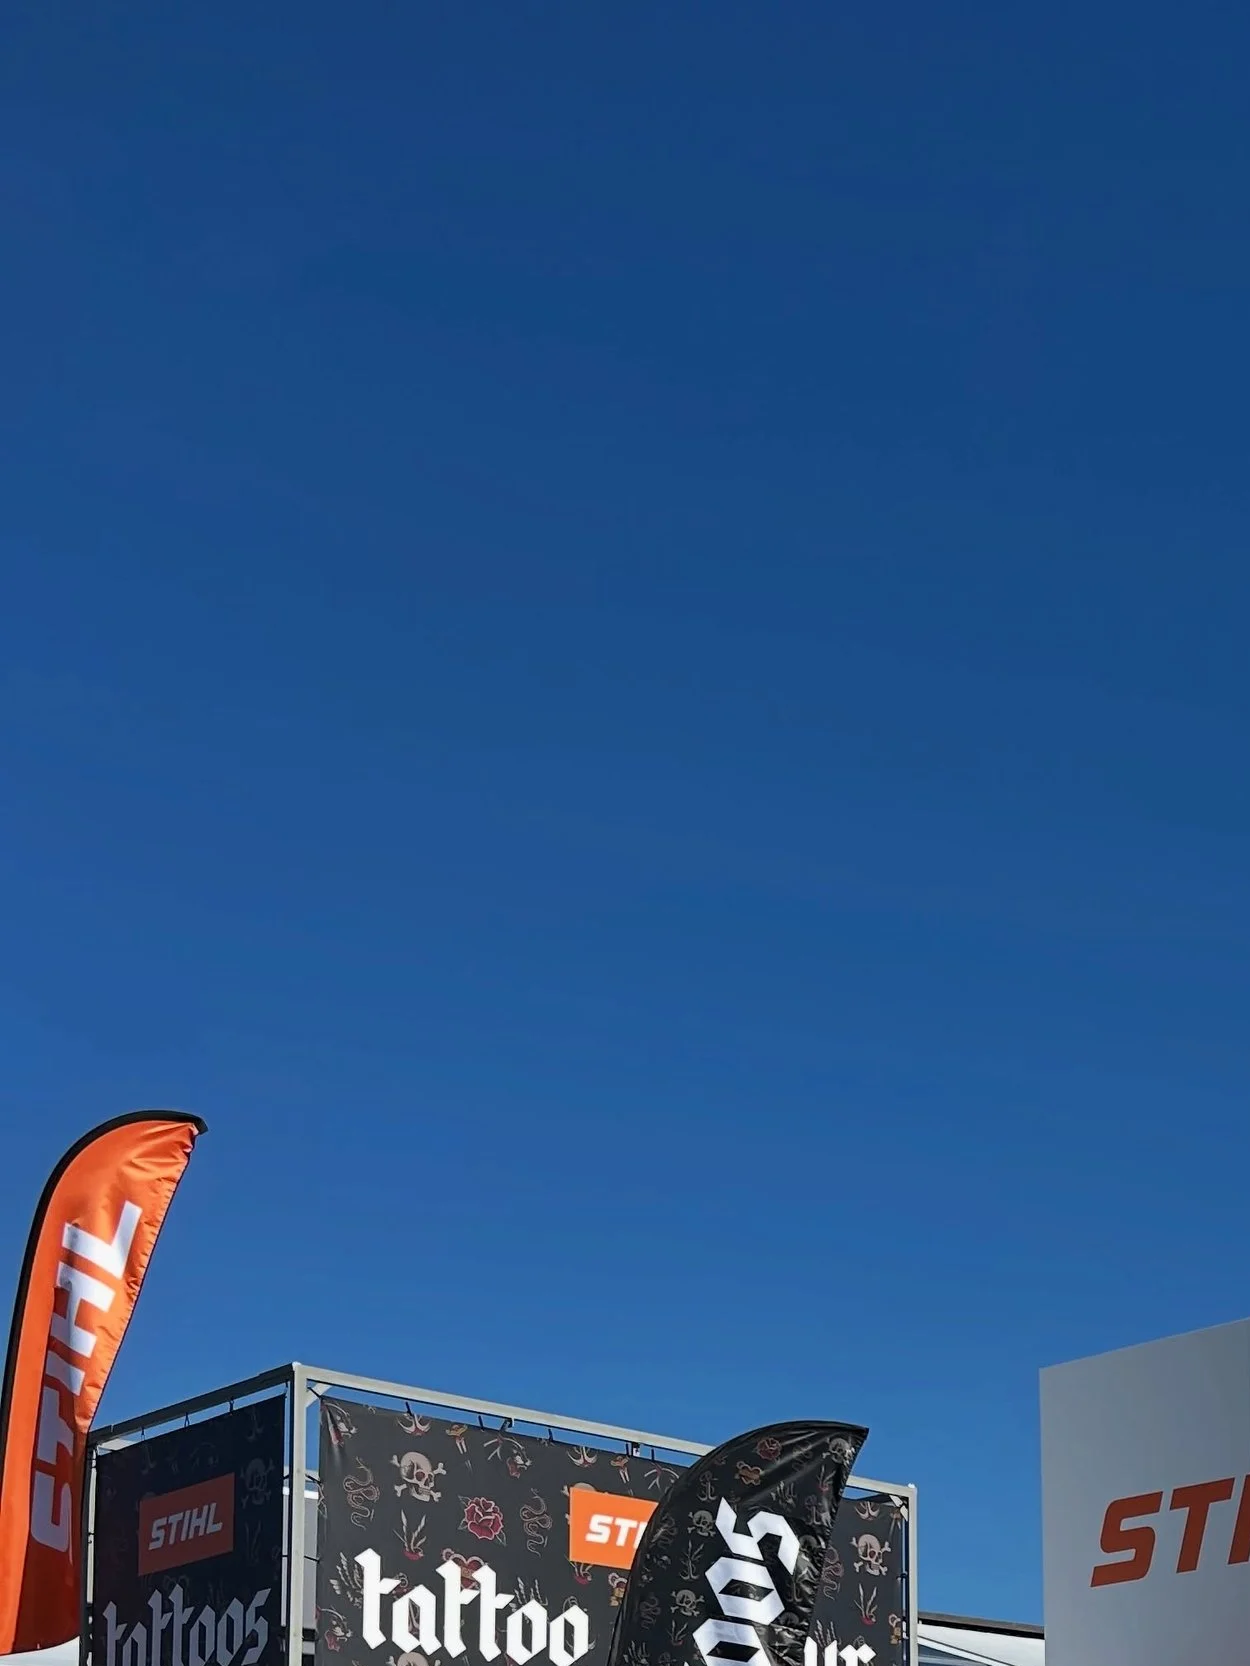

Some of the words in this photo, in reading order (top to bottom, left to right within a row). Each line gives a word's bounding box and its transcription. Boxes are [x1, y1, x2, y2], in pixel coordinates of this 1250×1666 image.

[30, 1200, 142, 1558] STIHL
[147, 1501, 224, 1551] STIHL
[585, 1513, 648, 1549] STI
